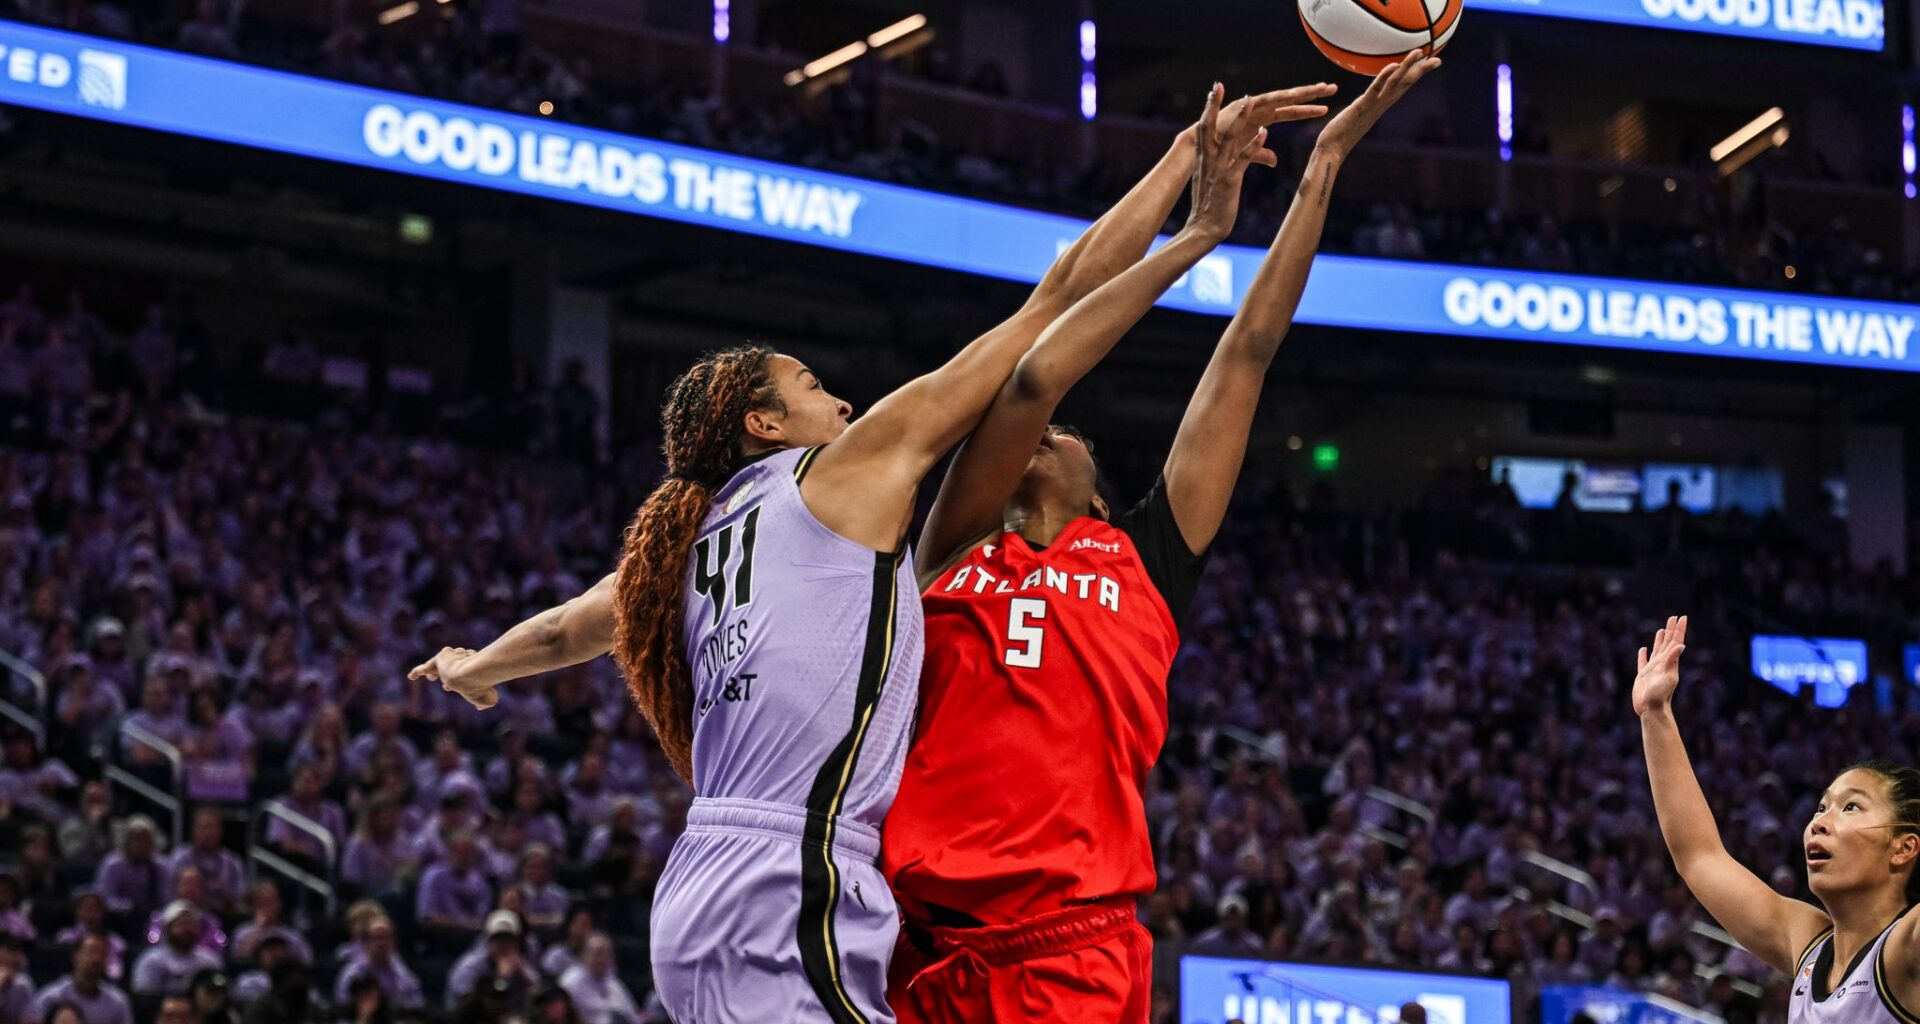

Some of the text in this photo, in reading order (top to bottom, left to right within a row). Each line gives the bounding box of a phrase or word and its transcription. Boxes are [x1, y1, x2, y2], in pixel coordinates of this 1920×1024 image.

[1773, 0, 1884, 39] LEAD
[0, 44, 71, 88] ED
[363, 104, 862, 238] GOOD LEADS THE WAY
[1443, 277, 1916, 361] GOOD LEADS THE WAY
[693, 502, 762, 629] 41
[1069, 538, 1120, 553] Albert
[944, 563, 1121, 613] ATLANTA
[701, 619, 748, 685] TOKES
[1004, 597, 1047, 669] 5
